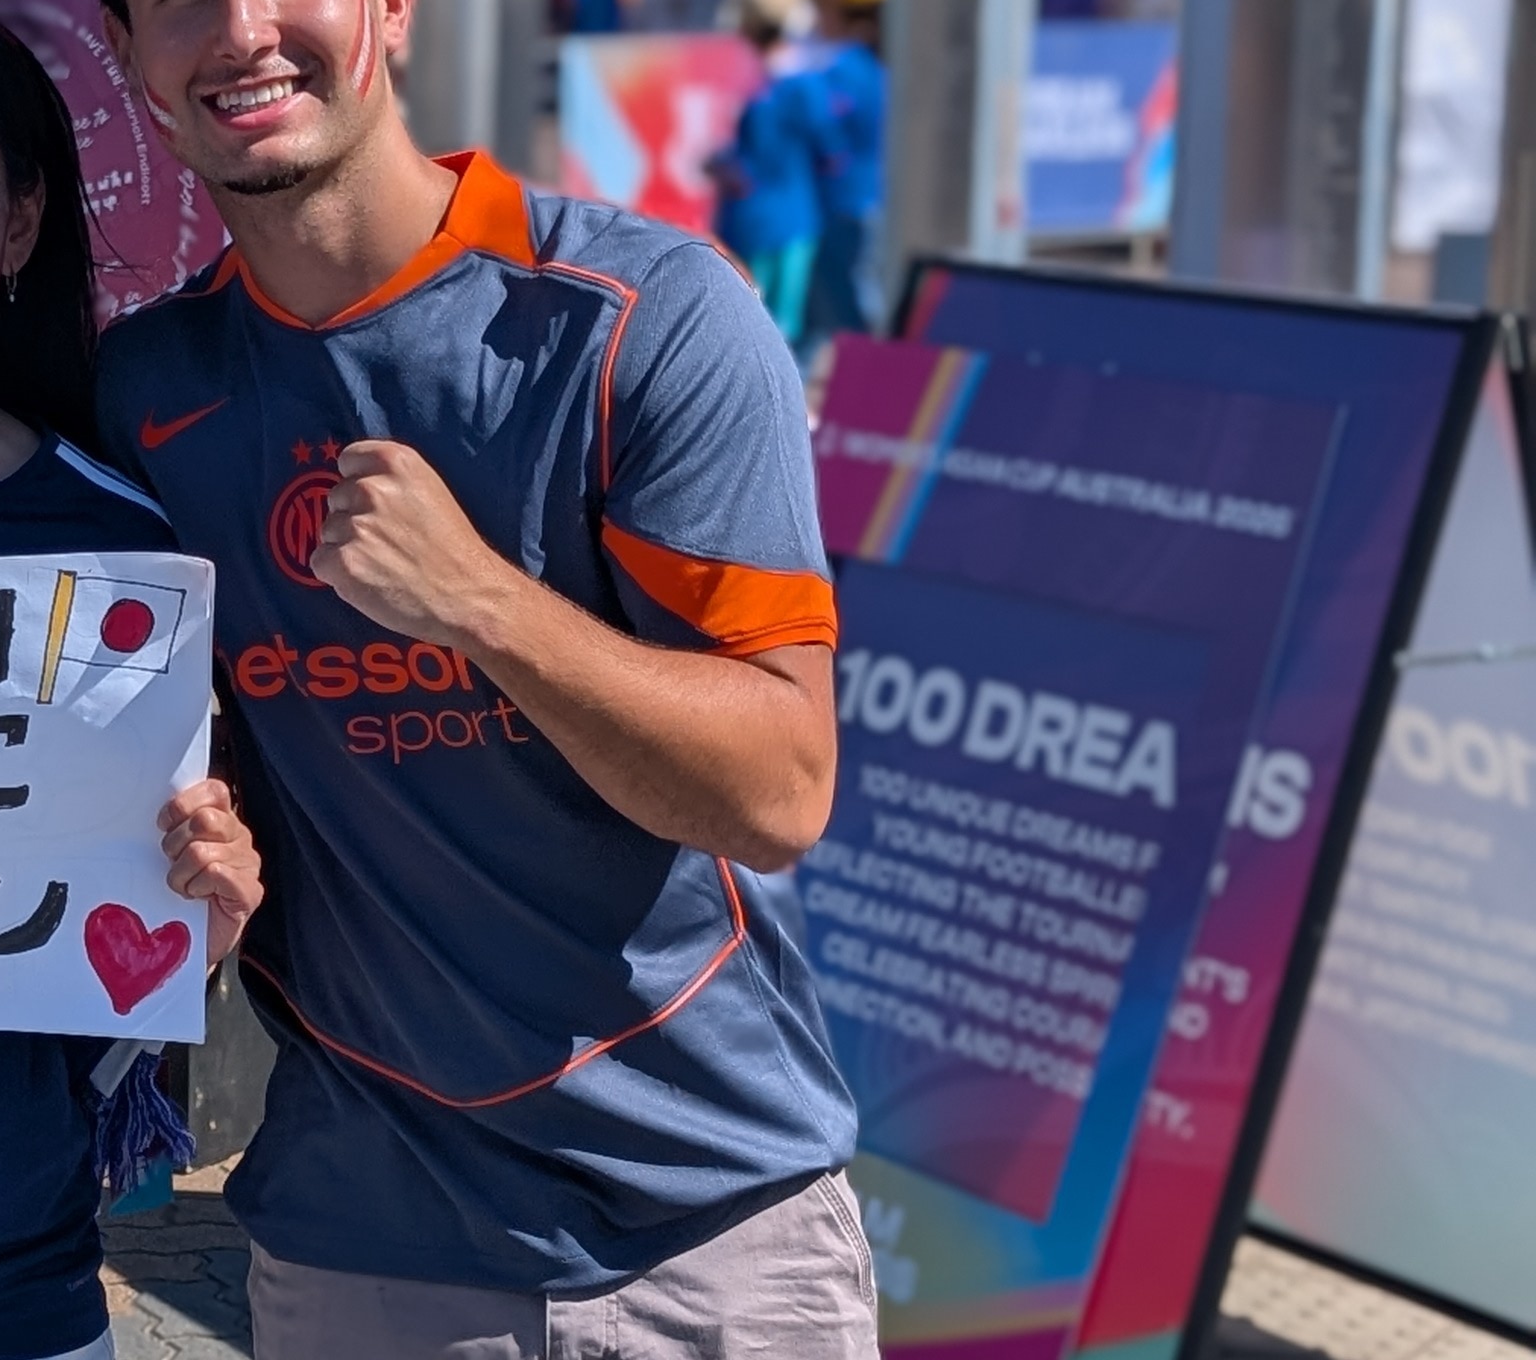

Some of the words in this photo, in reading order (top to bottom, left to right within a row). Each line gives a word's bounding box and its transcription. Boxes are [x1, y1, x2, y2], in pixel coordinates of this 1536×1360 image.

[346, 697, 529, 765] sport
[836, 647, 965, 748] 100
[804, 839, 958, 911] EFLECTING
[872, 811, 969, 868] YOUNG
[968, 839, 1149, 922] FOOTBALLE
